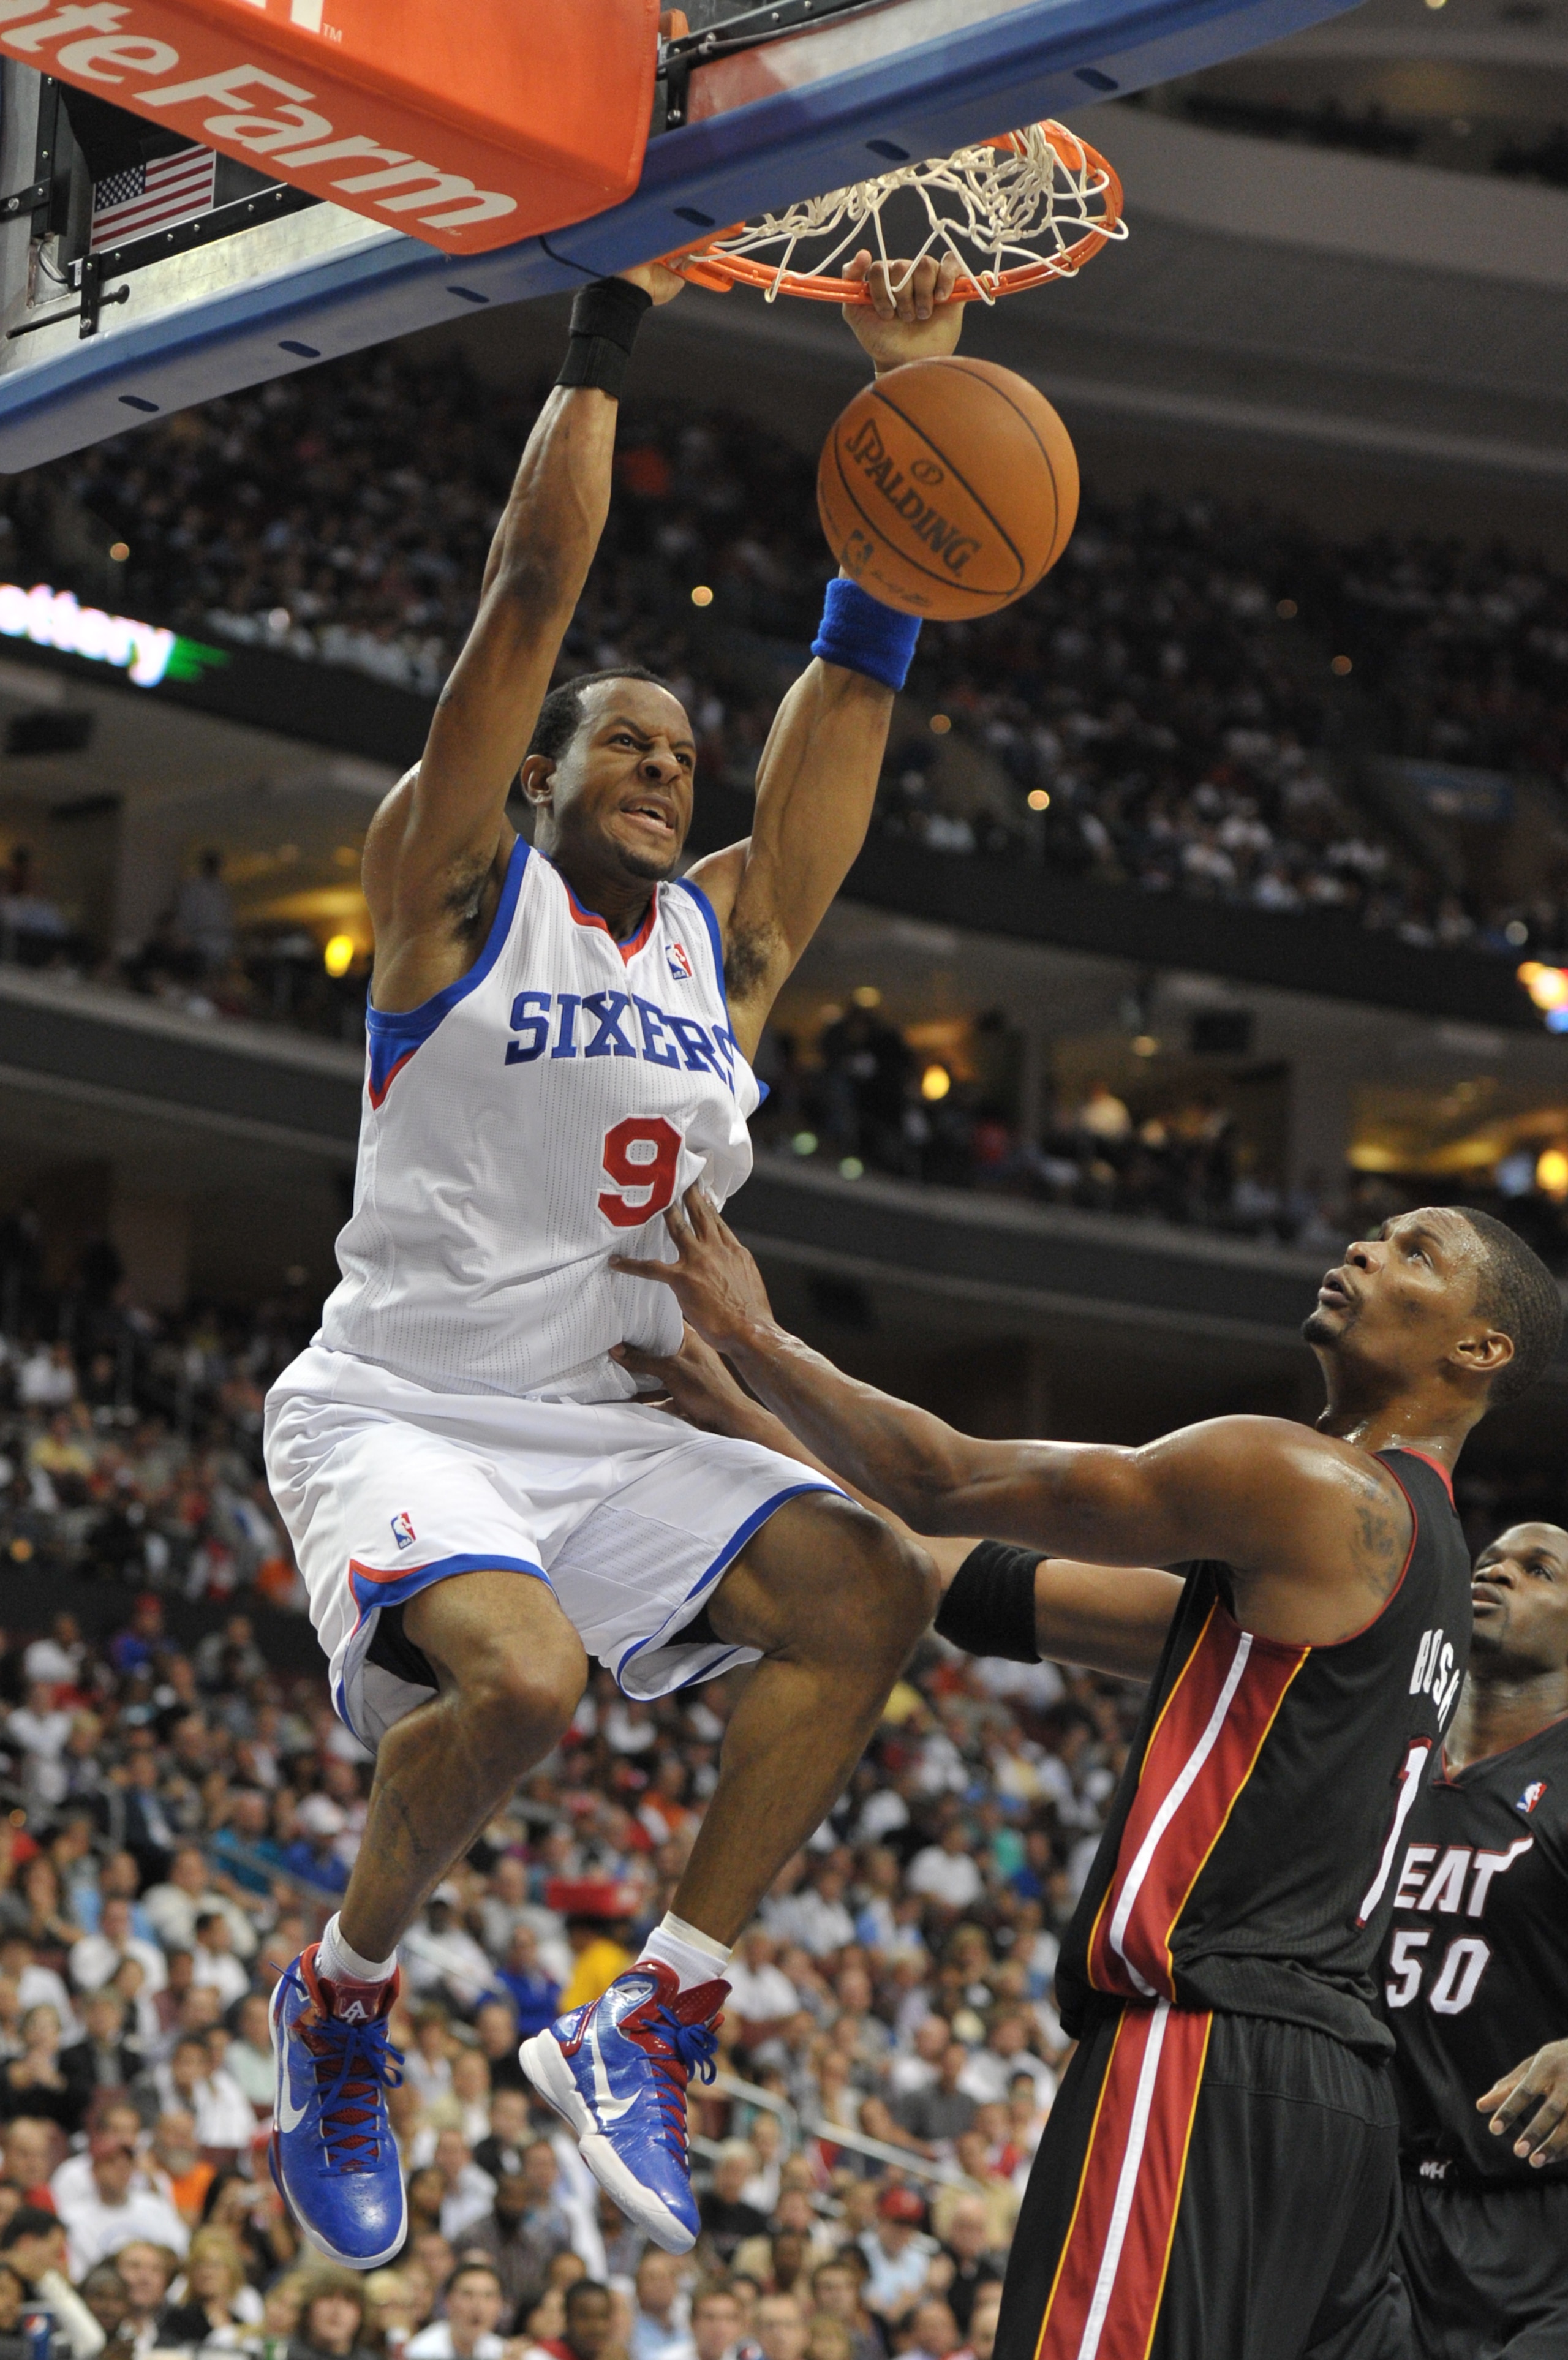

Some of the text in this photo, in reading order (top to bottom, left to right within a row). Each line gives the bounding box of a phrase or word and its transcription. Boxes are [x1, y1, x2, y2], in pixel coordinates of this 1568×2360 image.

[132, 63, 517, 229] Farm
[845, 418, 982, 575] SPALDING
[598, 1115, 683, 1227] 9
[1409, 1628, 1460, 1733] BOSH
[1355, 1736, 1433, 1928] 1
[1393, 1836, 1534, 1919] EAT
[1385, 1929, 1493, 2015] 50
